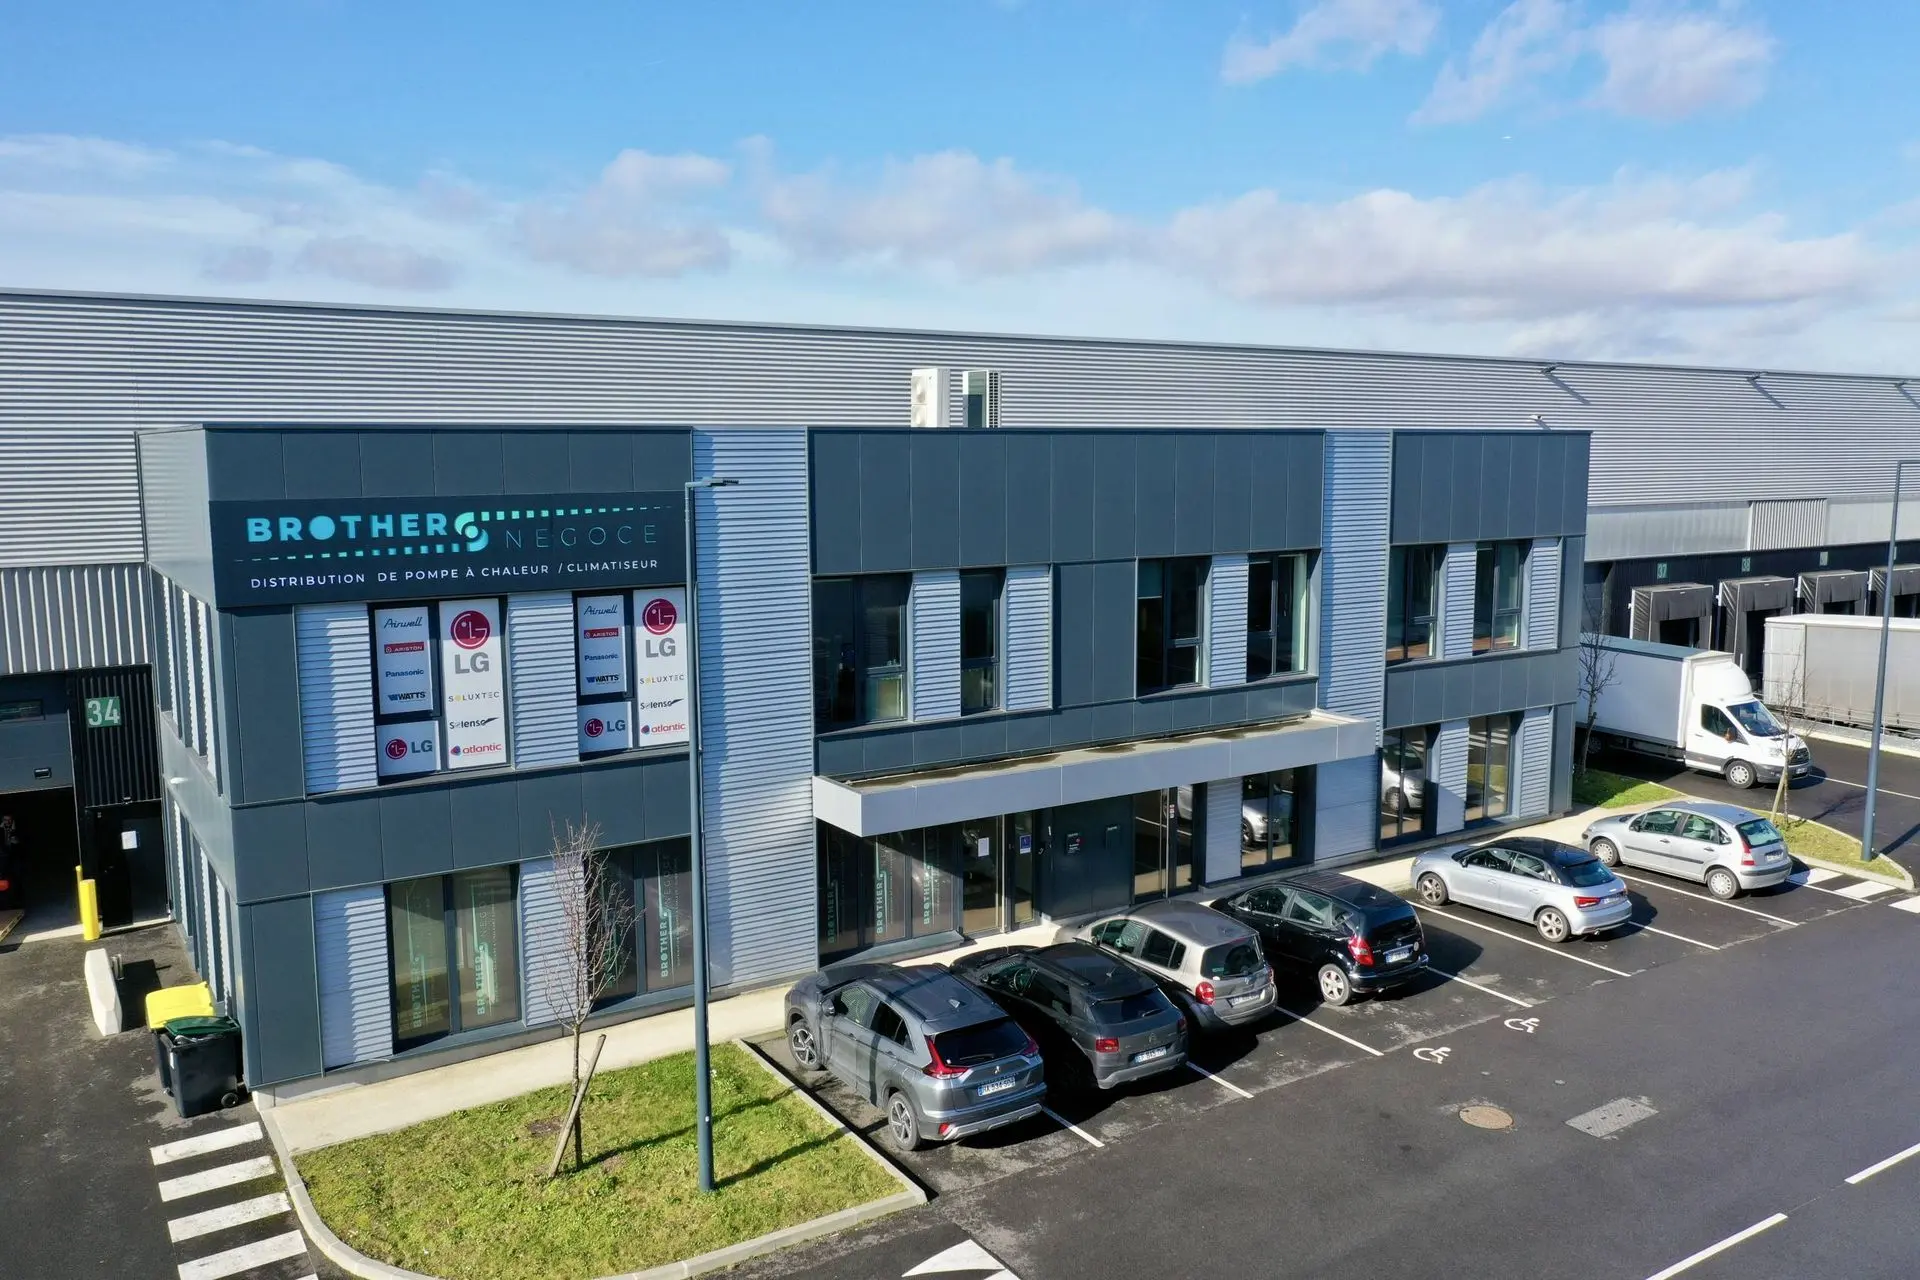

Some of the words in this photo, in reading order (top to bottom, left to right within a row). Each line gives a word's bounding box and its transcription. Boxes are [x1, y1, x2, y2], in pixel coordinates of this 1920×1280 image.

[505, 524, 657, 549] NEGOCE
[250, 573, 366, 588] DISTRIBUTION
[377, 571, 398, 582] DE
[405, 568, 459, 580] POMPE
[465, 566, 475, 577] À
[481, 564, 549, 577] CHALEUR
[584, 604, 618, 616] Airwell
[383, 616, 423, 629] Airwell
[645, 637, 676, 658] LG
[454, 651, 489, 675] LG
[584, 652, 619, 661] Panasonic
[385, 667, 425, 678] Panasonic
[87, 699, 121, 726] 34
[606, 719, 626, 732] LG
[651, 722, 686, 733] atlantic
[411, 739, 433, 754] LG
[462, 741, 502, 755] atlantic
